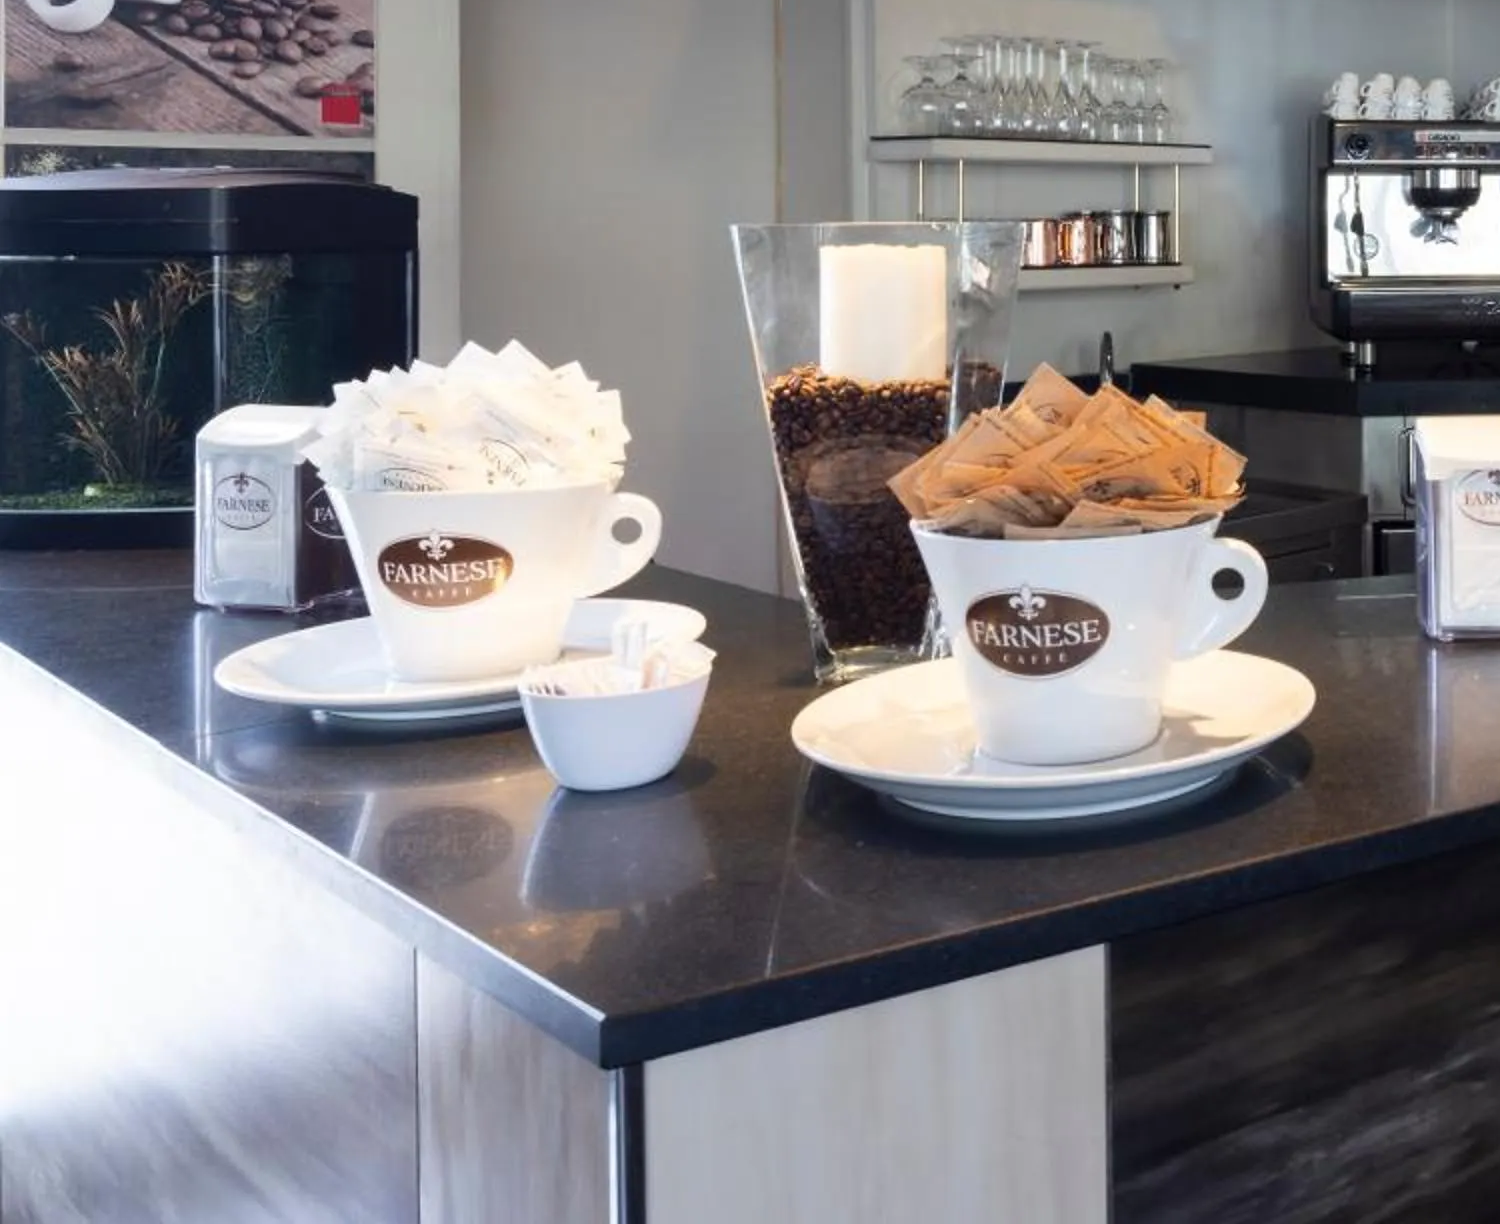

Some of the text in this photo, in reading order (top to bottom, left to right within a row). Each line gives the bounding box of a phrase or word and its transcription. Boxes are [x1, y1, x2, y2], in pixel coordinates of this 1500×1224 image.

[217, 497, 271, 513] FARNESE
[383, 557, 505, 585] FARNESE
[970, 619, 1102, 649] FARNESE
